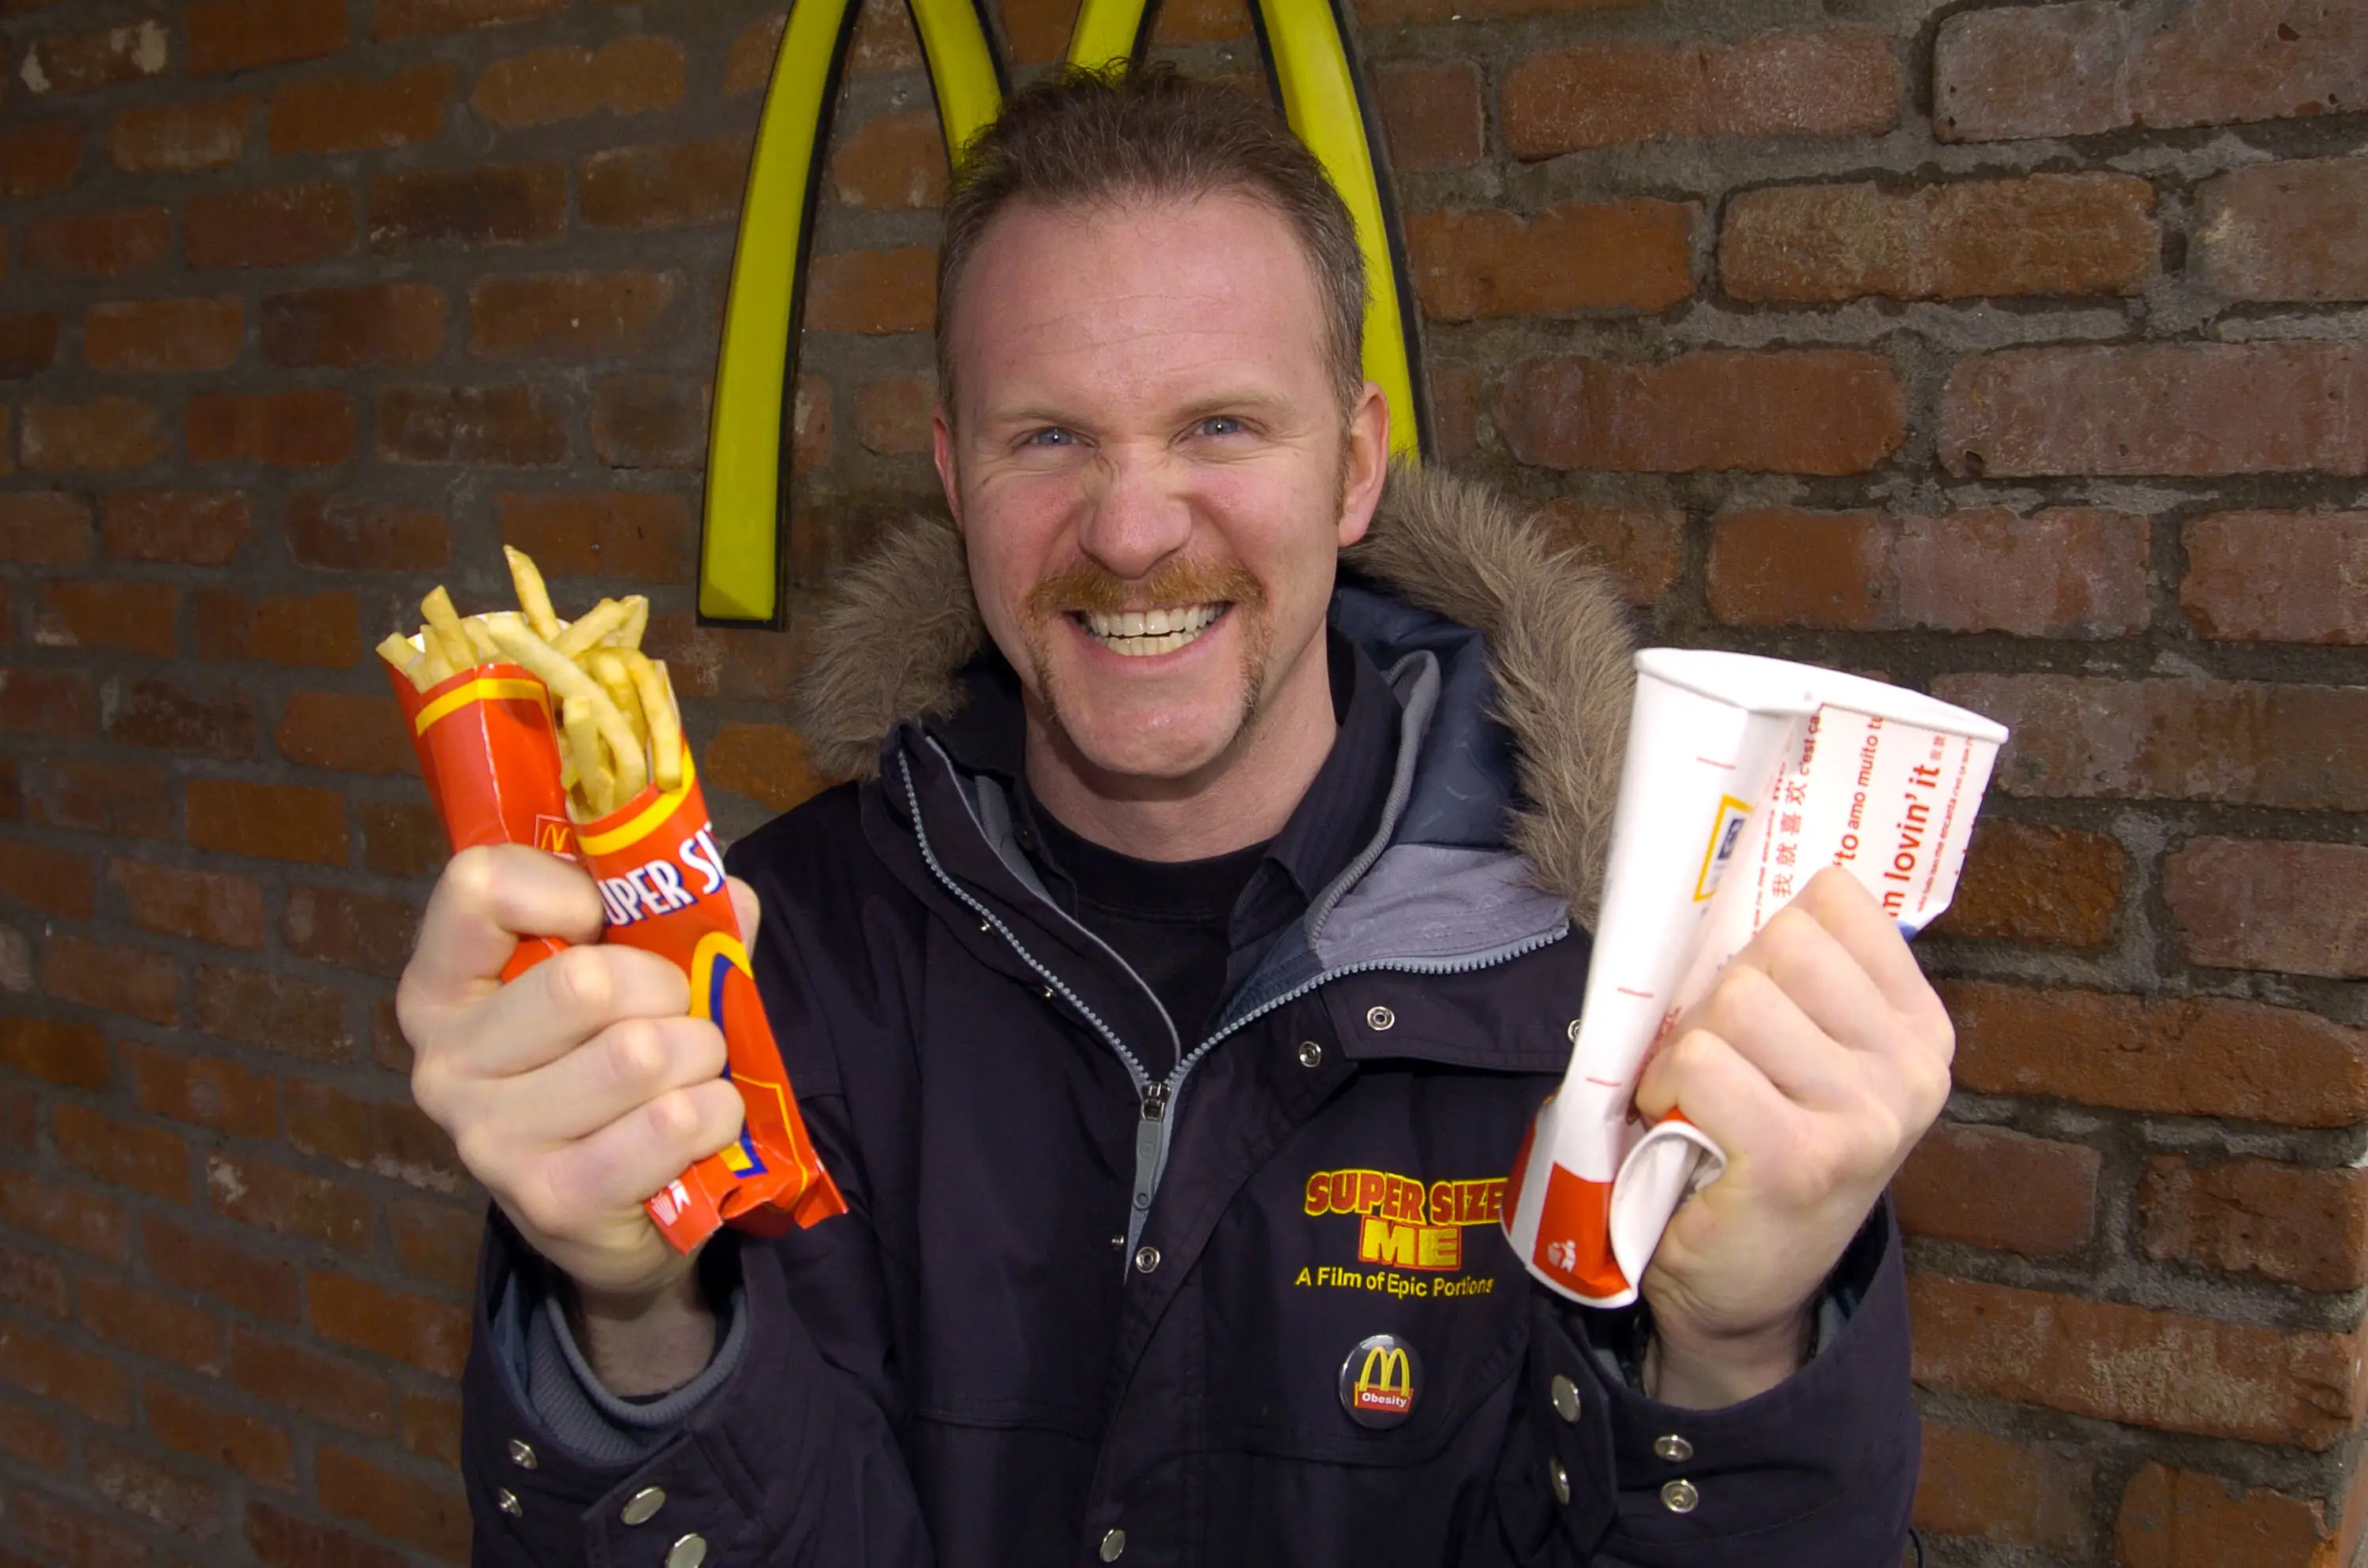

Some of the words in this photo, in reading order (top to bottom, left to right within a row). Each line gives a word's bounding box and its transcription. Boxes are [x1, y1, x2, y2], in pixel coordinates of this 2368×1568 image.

[1857, 735, 1879, 787] muito
[1849, 791, 1866, 830] amo
[1883, 791, 1930, 881] lovin'
[1909, 764, 1940, 789] it
[597, 859, 699, 926] UPER
[1305, 1169, 1427, 1226] SUPER
[1429, 1177, 1508, 1226] SIZE
[1358, 1215, 1461, 1270] ME
[1295, 1267, 1312, 1287] A
[1317, 1267, 1362, 1289] Film
[1366, 1271, 1385, 1291] of
[1387, 1273, 1428, 1299] Epic
[1433, 1275, 1494, 1297] Portions
[1362, 1392, 1407, 1408] Obesity
